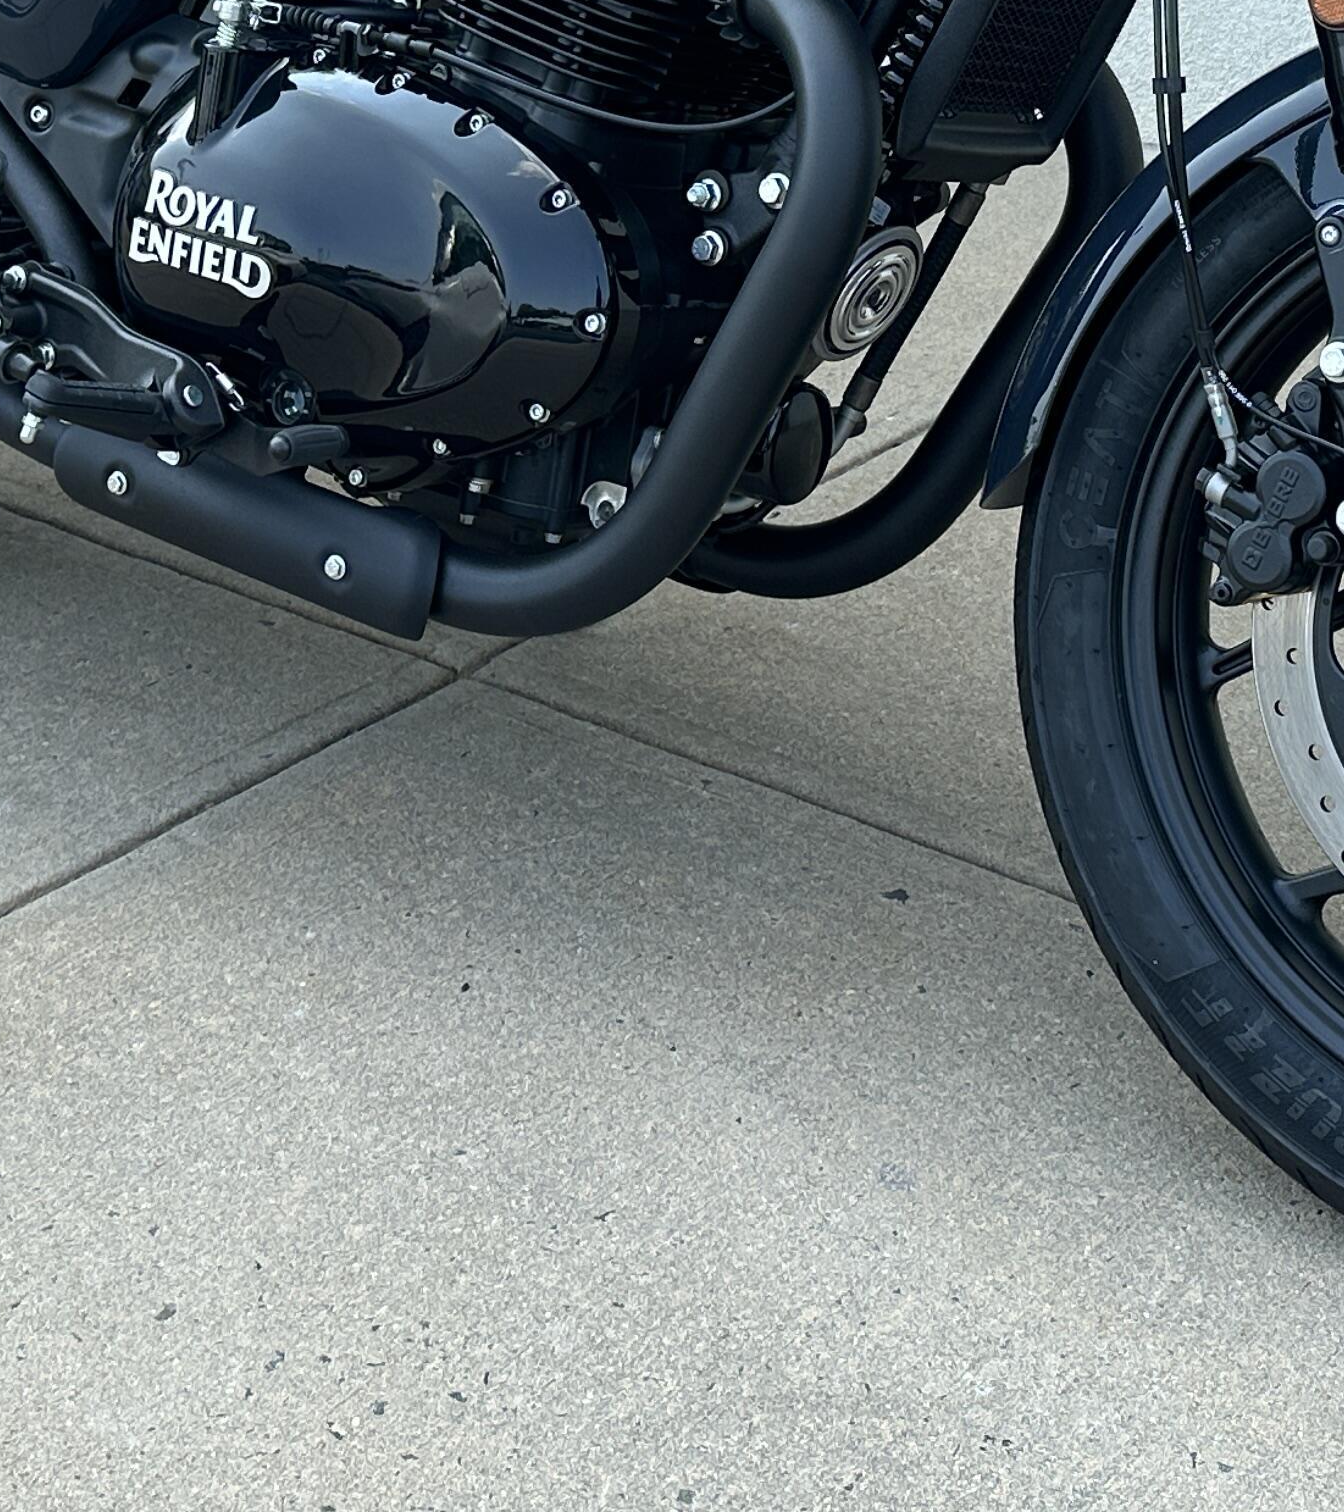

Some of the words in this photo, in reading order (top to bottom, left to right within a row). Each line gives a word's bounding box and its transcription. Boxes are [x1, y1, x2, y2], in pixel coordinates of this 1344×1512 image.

[144, 168, 260, 245] ROYAL
[128, 216, 272, 300] ENFIELD
[1059, 379, 1144, 549] CEAT
